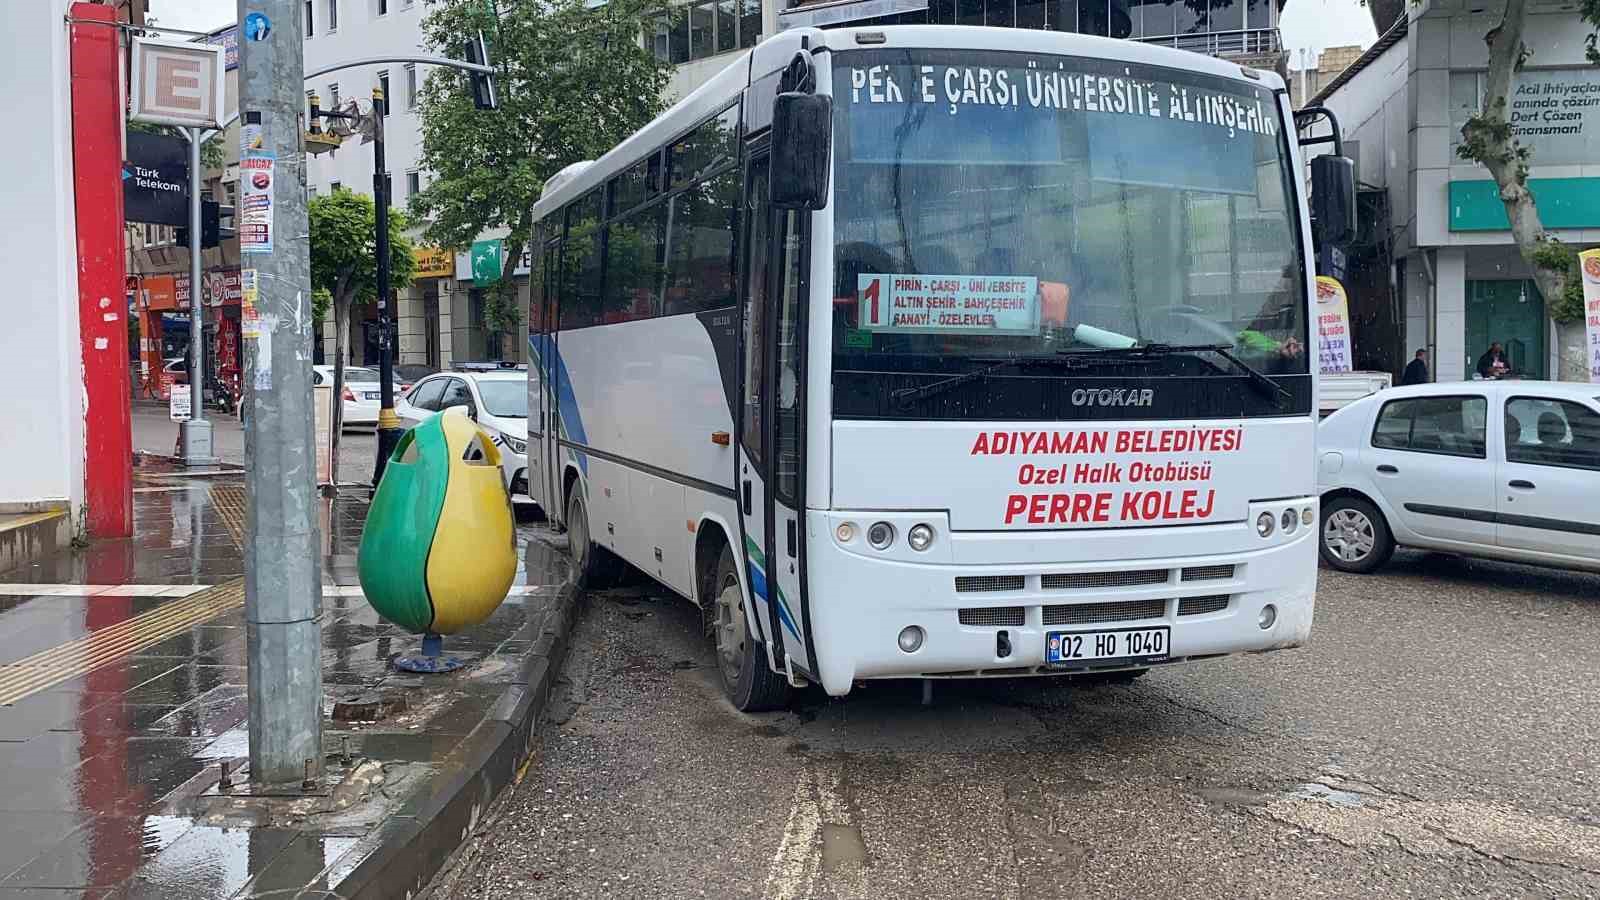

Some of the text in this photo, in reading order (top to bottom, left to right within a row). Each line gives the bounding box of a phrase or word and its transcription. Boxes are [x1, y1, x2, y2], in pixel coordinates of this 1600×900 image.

[156, 56, 201, 110] E
[1025, 61, 1161, 117] ÜNİVERSİTE
[1516, 82, 1541, 95] Acil
[1513, 97, 1559, 109] anında
[1511, 109, 1582, 124] Dert Çözen
[135, 166, 160, 179] Türk
[135, 177, 181, 192] Telekom
[894, 277, 922, 292] PİRİN
[930, 278, 960, 295] ÇARŞI
[864, 278, 880, 324] 1
[894, 296, 923, 309] ALTIN
[926, 295, 957, 313] ŞEHİR
[964, 295, 1026, 313] BAHÇEŞEHİR
[1071, 388, 1154, 407] OTOKAR
[971, 423, 1244, 456] ADIYAMAN BELEDİYESİ
[1073, 462, 1122, 484] Halk
[1128, 460, 1212, 483] Otobüsü
[1004, 488, 1216, 524] PERRE KOLEJ
[1061, 636, 1083, 658] 02
[1126, 631, 1163, 655] 1040
